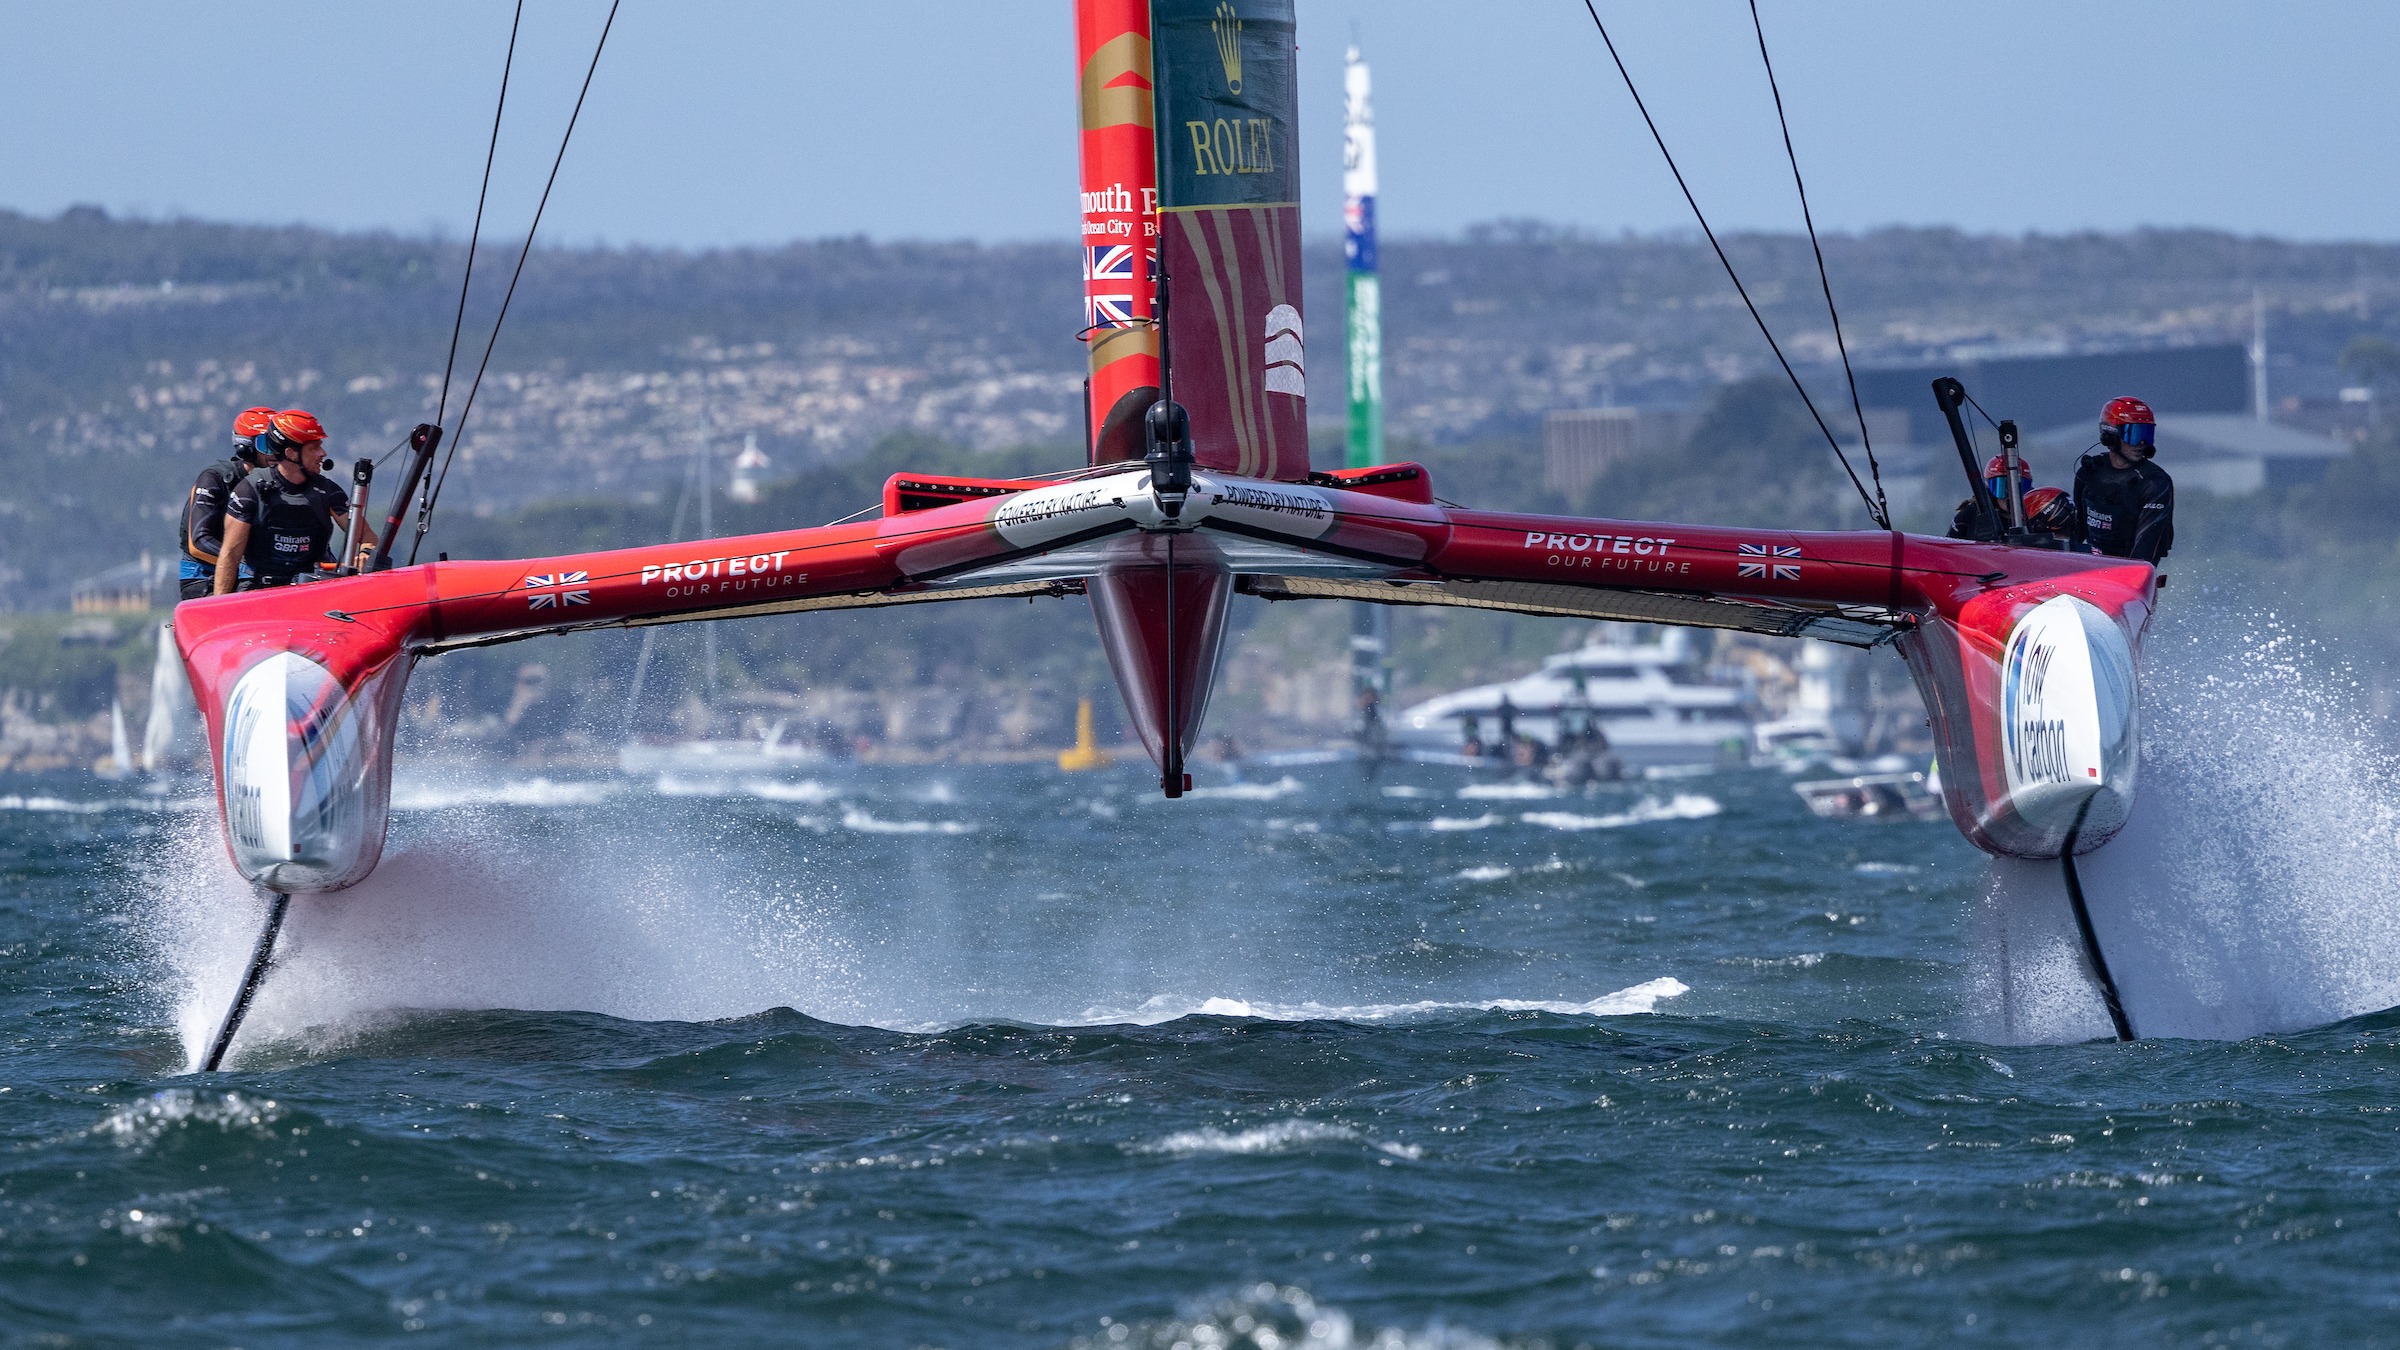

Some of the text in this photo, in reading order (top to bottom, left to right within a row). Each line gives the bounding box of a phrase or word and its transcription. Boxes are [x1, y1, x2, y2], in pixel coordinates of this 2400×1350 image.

[1186, 118, 1274, 176] ROLEX
[1107, 219, 1133, 237] City
[1224, 485, 1273, 511] POWERED
[1271, 492, 1286, 513] BY
[999, 500, 1045, 528] POWERED
[1045, 497, 1060, 519] BY
[274, 533, 310, 544] Emirates
[274, 543, 299, 552] GBR
[1524, 531, 1676, 556] PROTECT
[641, 551, 790, 585] PROTECT
[1547, 555, 1691, 574] OUR FUTURE
[666, 573, 809, 598] OUR FUTURE
[2024, 699, 2071, 783] carbon
